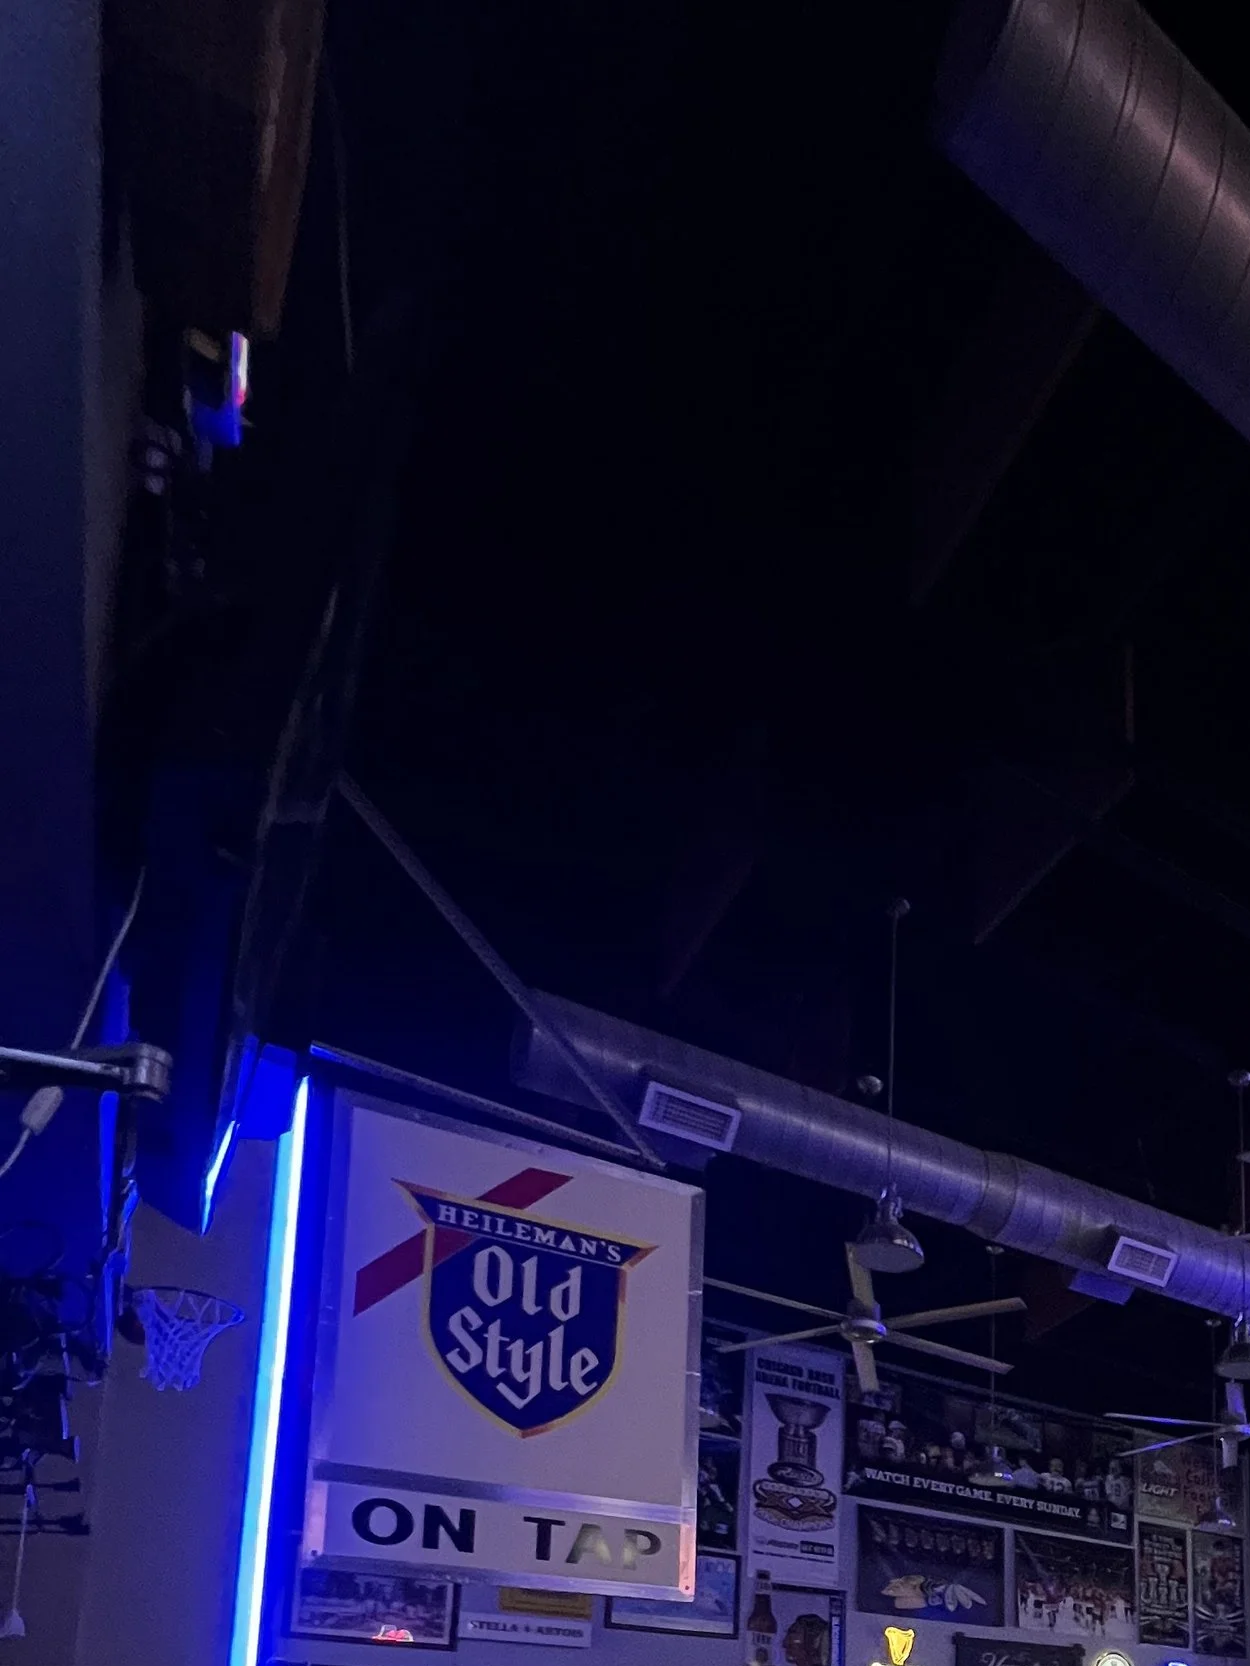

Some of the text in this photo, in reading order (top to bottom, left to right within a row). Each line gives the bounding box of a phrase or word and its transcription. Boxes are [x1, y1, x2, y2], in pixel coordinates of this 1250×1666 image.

[436, 1203, 623, 1264] HEILEMAN'S
[472, 1245, 583, 1323] Old
[445, 1305, 600, 1411] Style
[864, 1466, 910, 1486] WATCH
[913, 1477, 953, 1497] EVERY
[996, 1494, 1035, 1511] EVERY
[1140, 1482, 1180, 1499] LIGHT
[353, 1498, 662, 1572] ON TAP
[469, 1618, 585, 1638] STELLA ARTOIS
